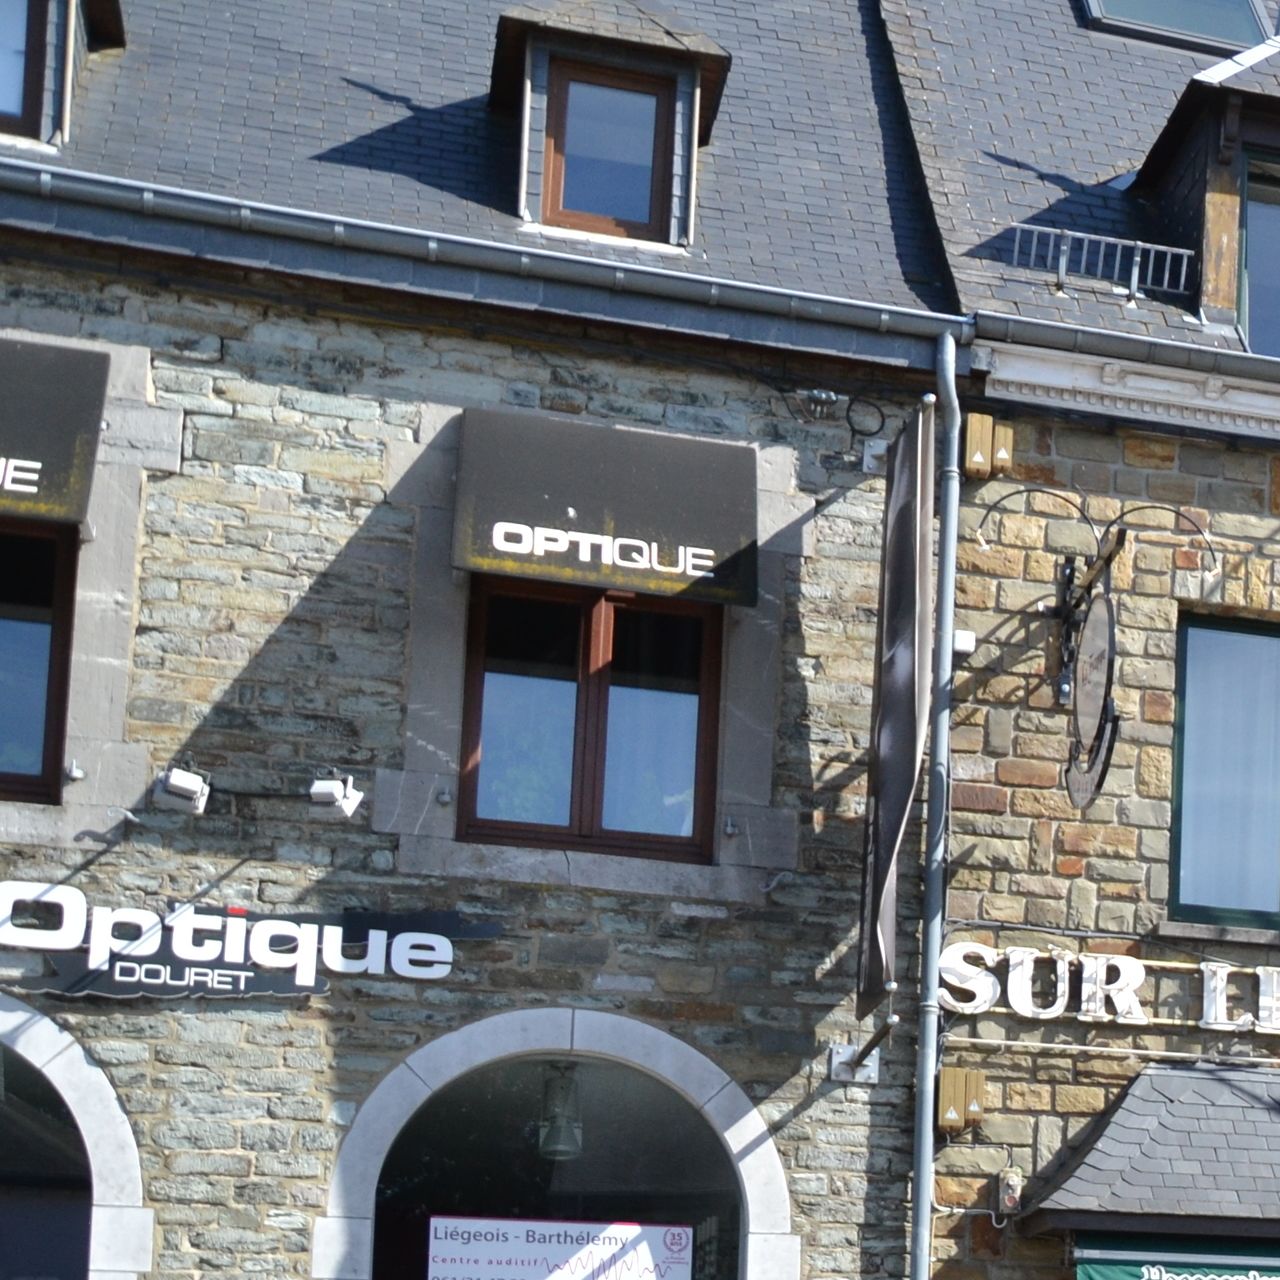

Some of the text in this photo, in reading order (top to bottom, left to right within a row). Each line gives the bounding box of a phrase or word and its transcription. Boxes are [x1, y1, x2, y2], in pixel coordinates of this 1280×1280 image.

[493, 522, 715, 577] OPTIQUE
[0, 880, 453, 986] Optique
[114, 962, 254, 991] DOURET
[936, 942, 1149, 1025] SUR
[433, 1226, 508, 1245] Liégeois
[526, 1229, 628, 1250] Barthélemy
[432, 1255, 539, 1267] Centre auditif
